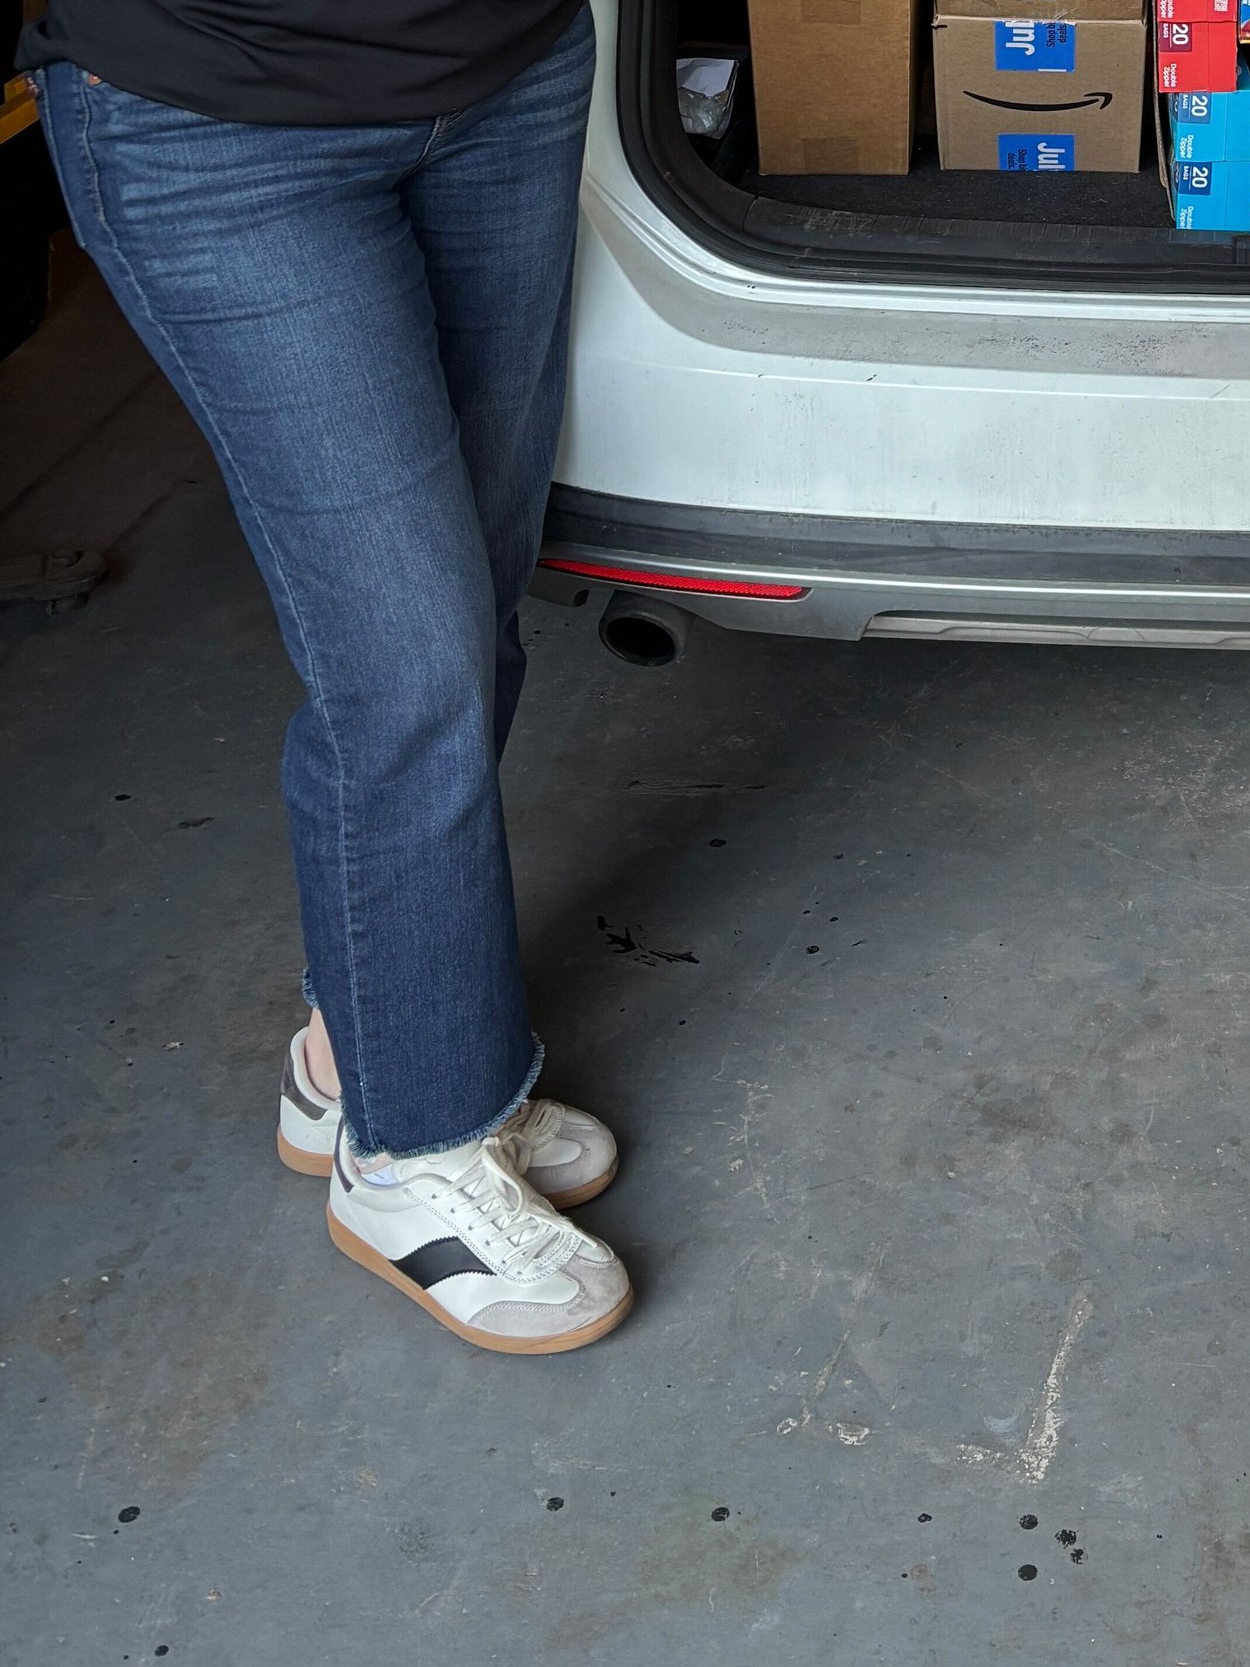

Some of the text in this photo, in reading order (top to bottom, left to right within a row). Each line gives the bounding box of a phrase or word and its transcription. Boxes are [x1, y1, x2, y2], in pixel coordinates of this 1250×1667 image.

[1005, 20, 1036, 56] Jul
[1172, 24, 1189, 45] 20
[1191, 95, 1208, 116] 20
[1038, 142, 1066, 171] Jul
[1192, 167, 1208, 188] 20
